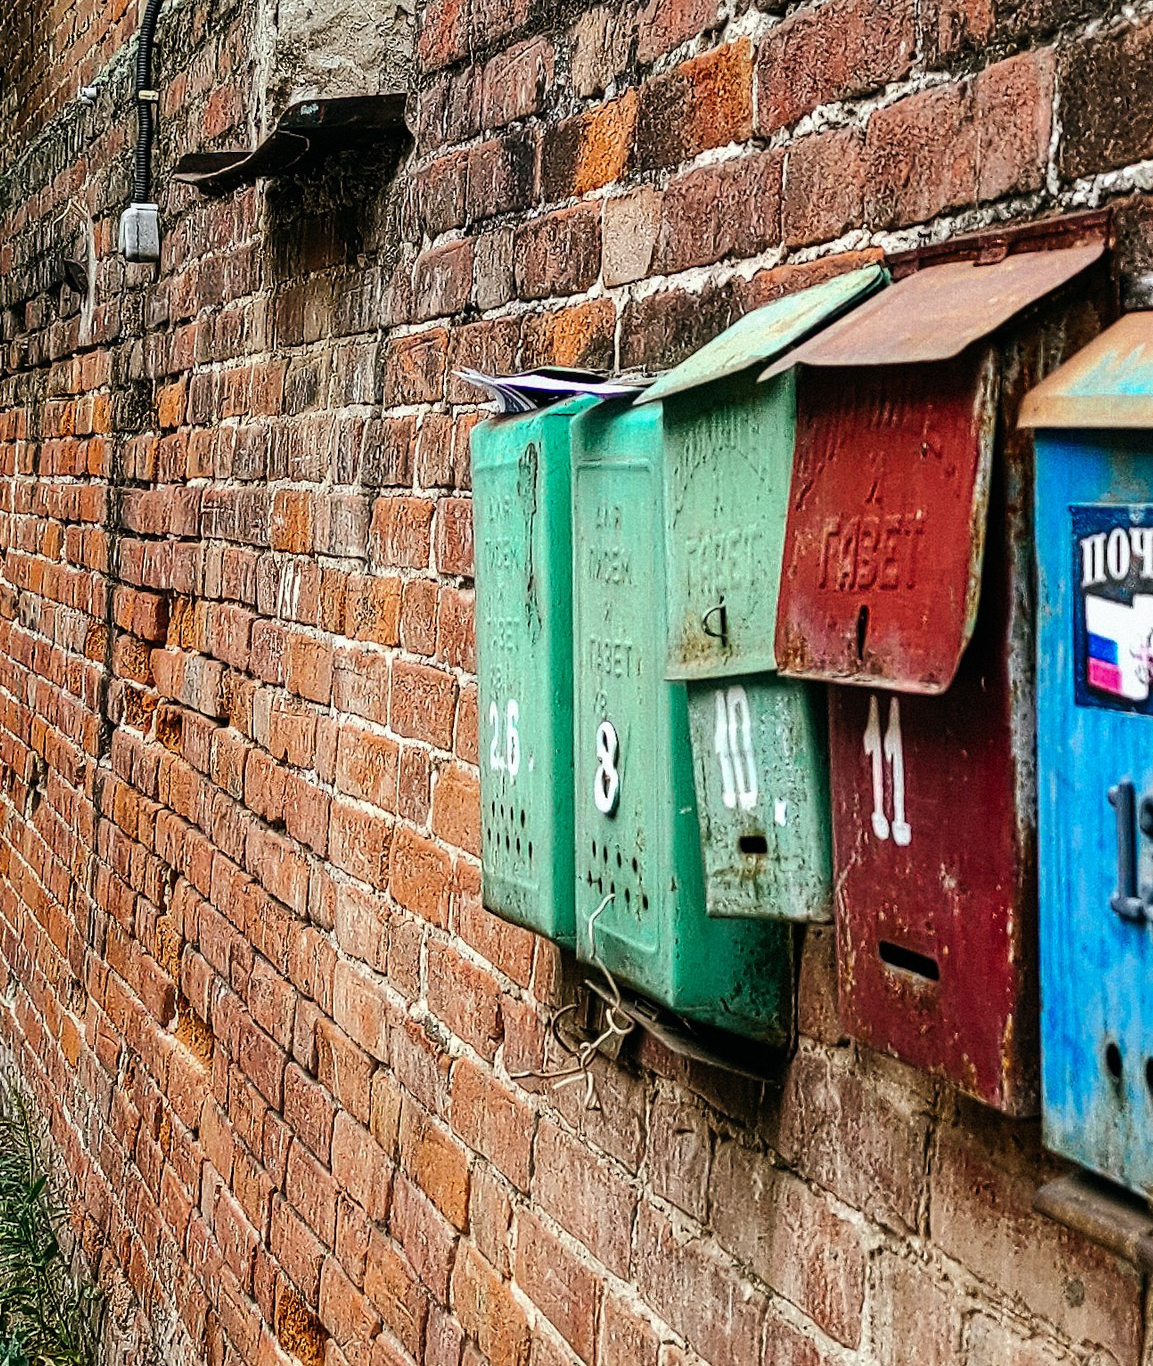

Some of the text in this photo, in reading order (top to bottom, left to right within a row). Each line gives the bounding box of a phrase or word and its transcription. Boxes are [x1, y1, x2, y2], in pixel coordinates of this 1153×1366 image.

[489, 698, 521, 775] 26
[594, 720, 621, 815] 8
[714, 684, 759, 811] 10
[863, 693, 912, 847] 11
